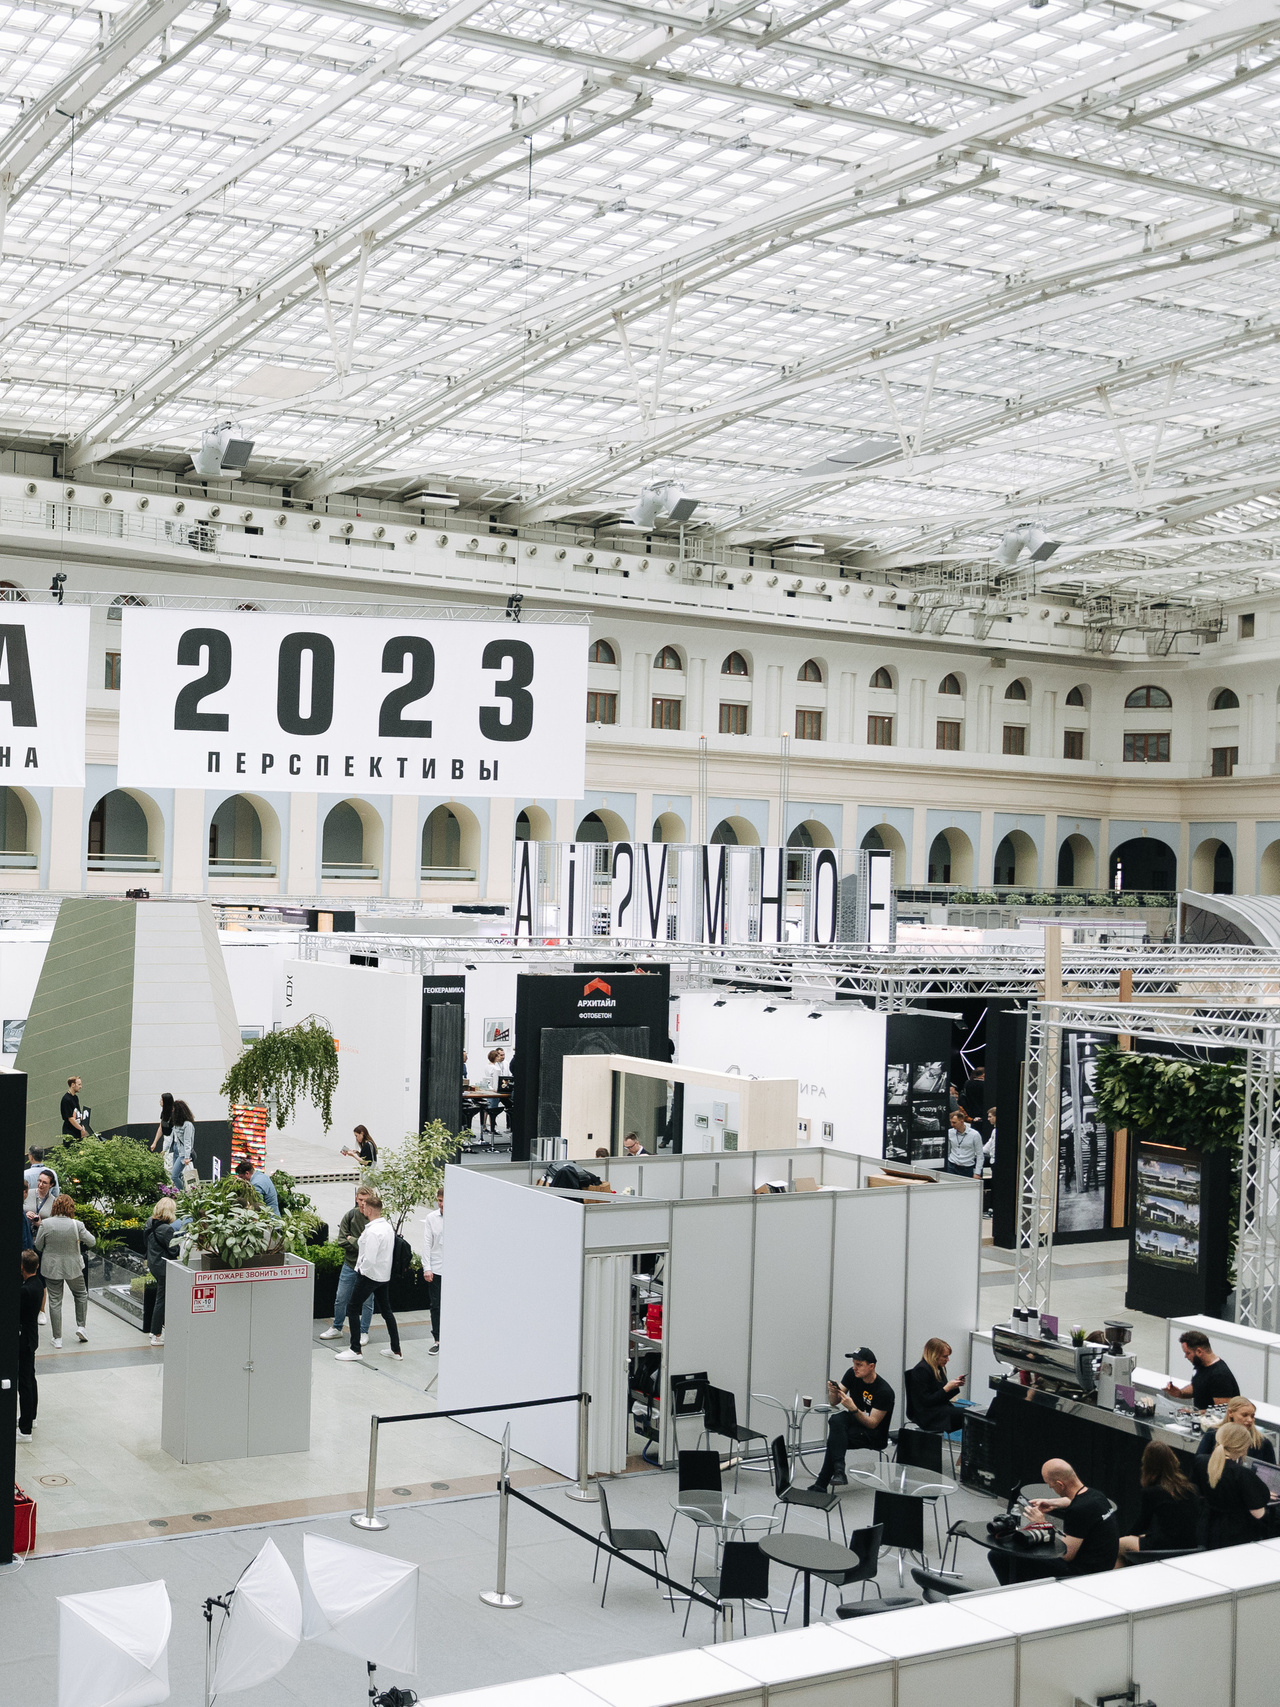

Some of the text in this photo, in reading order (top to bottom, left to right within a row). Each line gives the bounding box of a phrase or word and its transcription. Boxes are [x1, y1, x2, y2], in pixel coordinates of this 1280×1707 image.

[174, 627, 535, 742] 2023
[207, 751, 499, 781] ПЕРСПЕКТИВЫ
[423, 986, 464, 994] ГЕОКЕРАМИКА
[577, 998, 616, 1007] АРХИТАЙЛ
[800, 1083, 827, 1098] ИРА
[197, 1274, 212, 1282] ПРИ
[214, 1272, 244, 1281] ПОЖАРЕ
[245, 1270, 278, 1279] ЗВОНИТЬ
[280, 1269, 293, 1277] 101,
